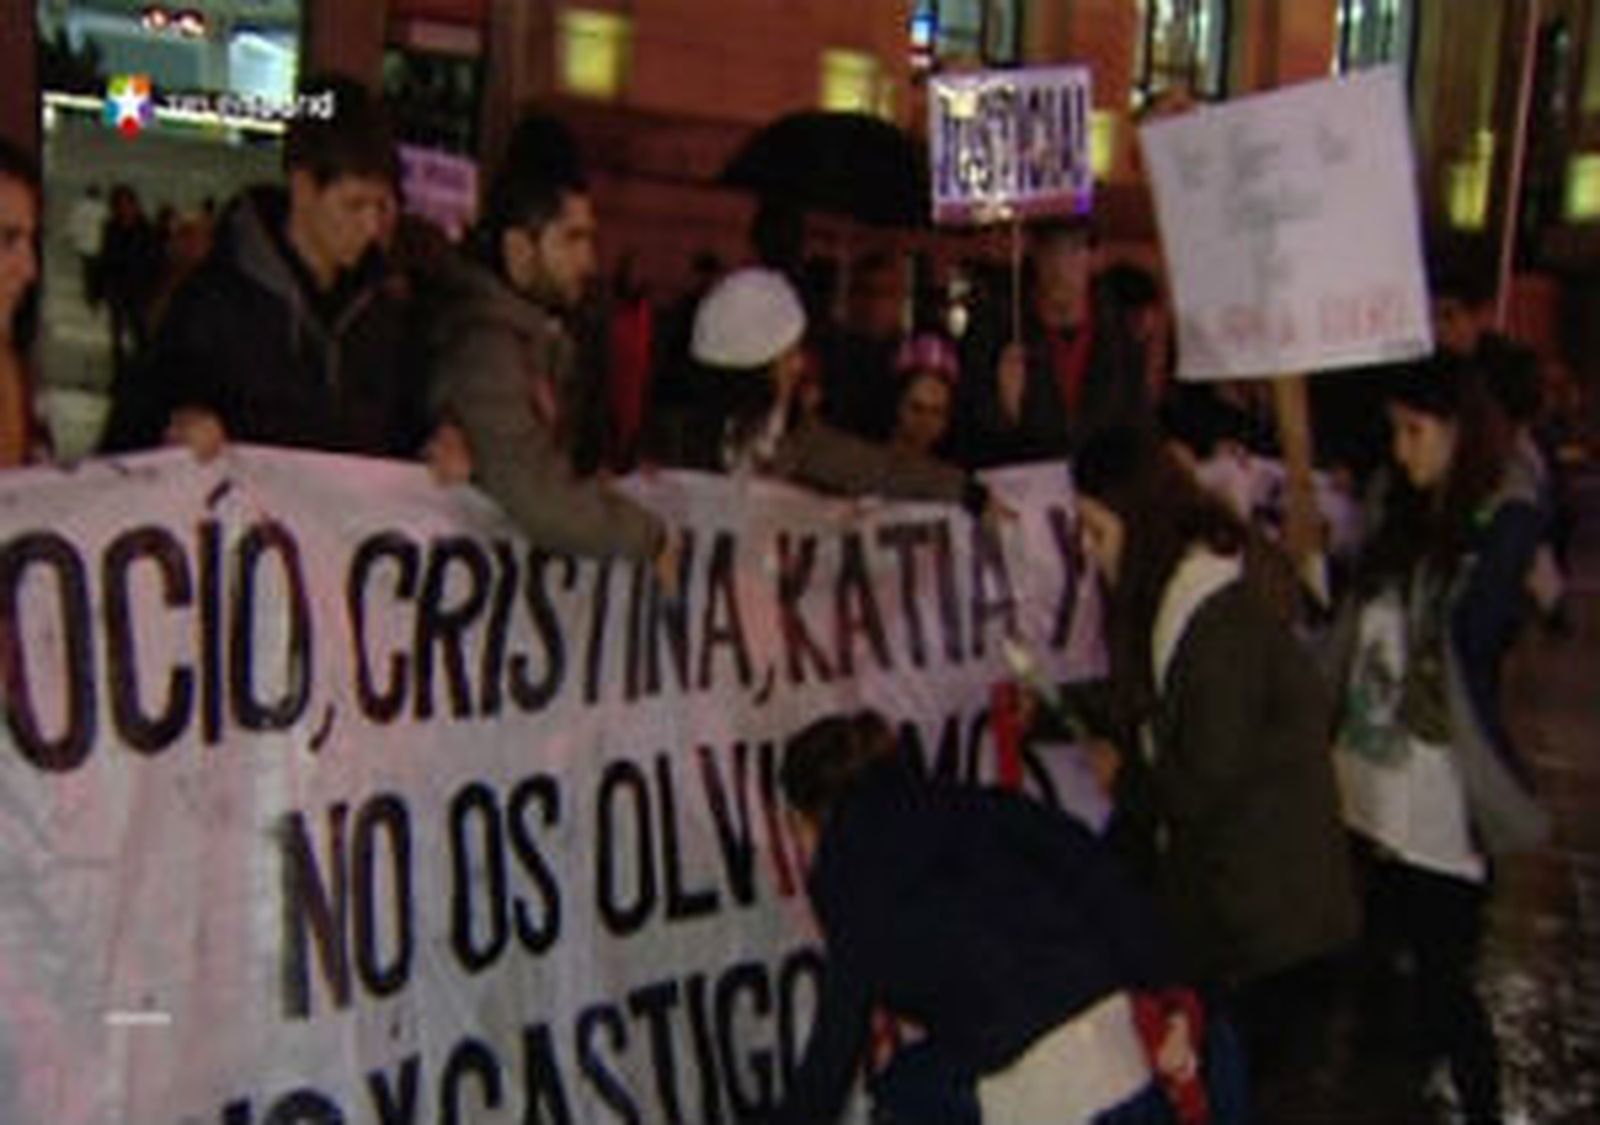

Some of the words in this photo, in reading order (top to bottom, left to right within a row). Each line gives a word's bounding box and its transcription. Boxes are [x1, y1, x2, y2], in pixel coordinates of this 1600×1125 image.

[776, 517, 1020, 686] KATIA
[280, 793, 412, 1022] NO
[450, 774, 561, 974] OS
